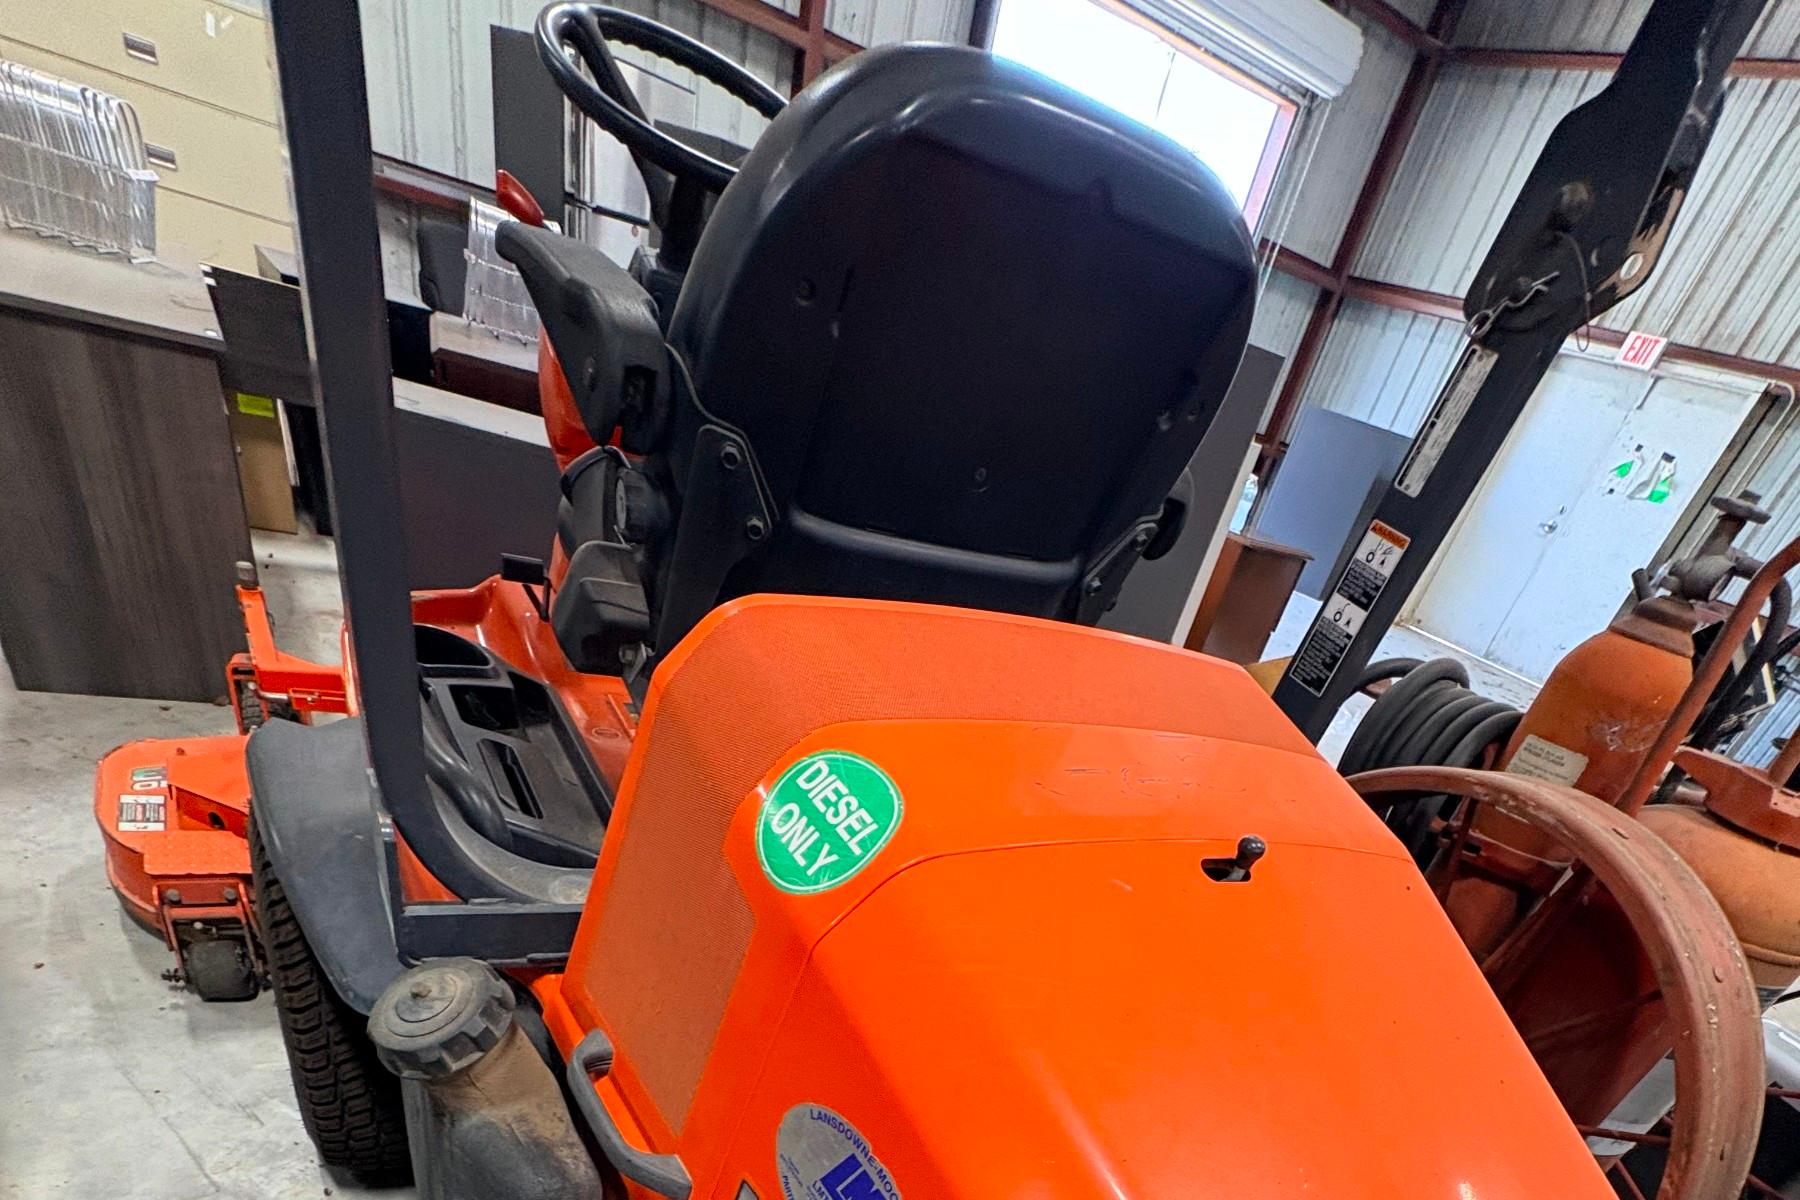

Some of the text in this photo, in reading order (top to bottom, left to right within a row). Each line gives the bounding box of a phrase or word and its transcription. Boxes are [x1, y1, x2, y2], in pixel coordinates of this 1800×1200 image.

[1622, 335, 1661, 366] EXIT
[771, 803, 840, 876] ONLY
[796, 760, 879, 856] DIESEL
